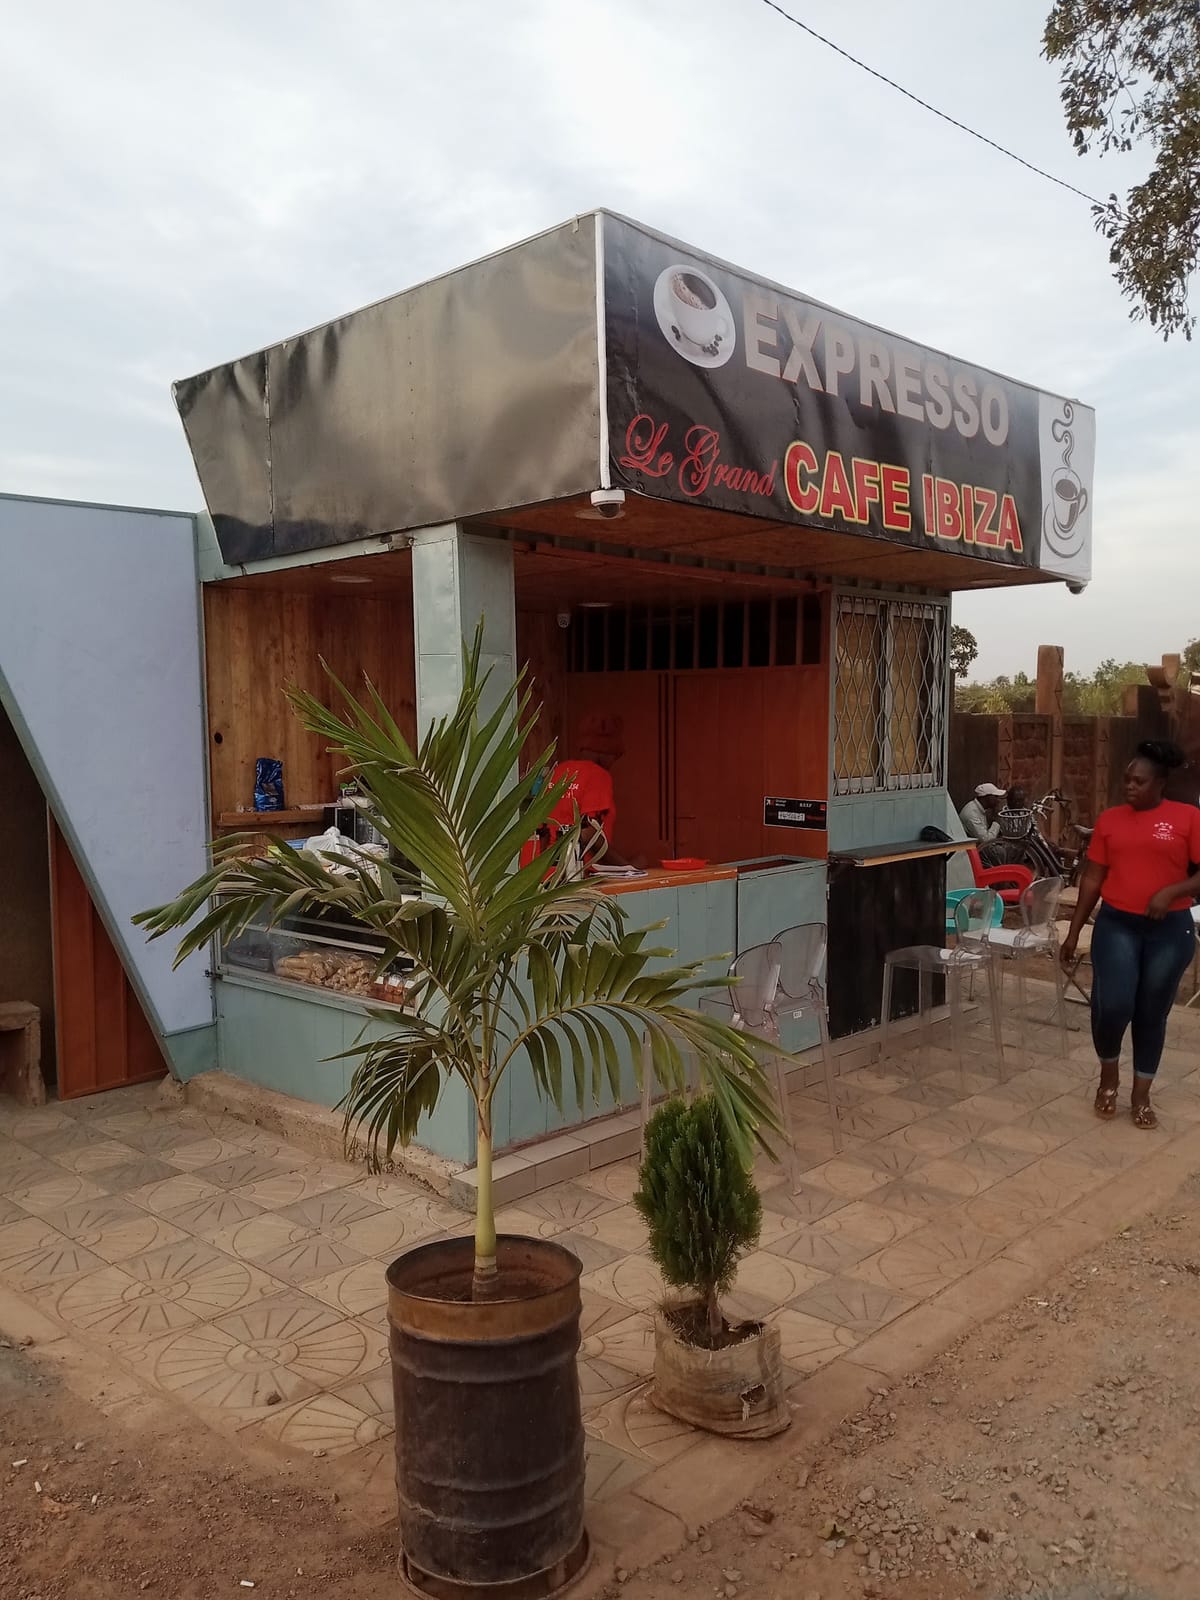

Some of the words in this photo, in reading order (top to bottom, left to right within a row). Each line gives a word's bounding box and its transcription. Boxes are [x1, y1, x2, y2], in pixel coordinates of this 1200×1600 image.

[743, 294, 1010, 447] EXPRESSO
[620, 414, 673, 477] Le
[678, 425, 778, 496] Grand
[785, 440, 912, 532] CAFE
[922, 473, 1024, 553] IBIZA
